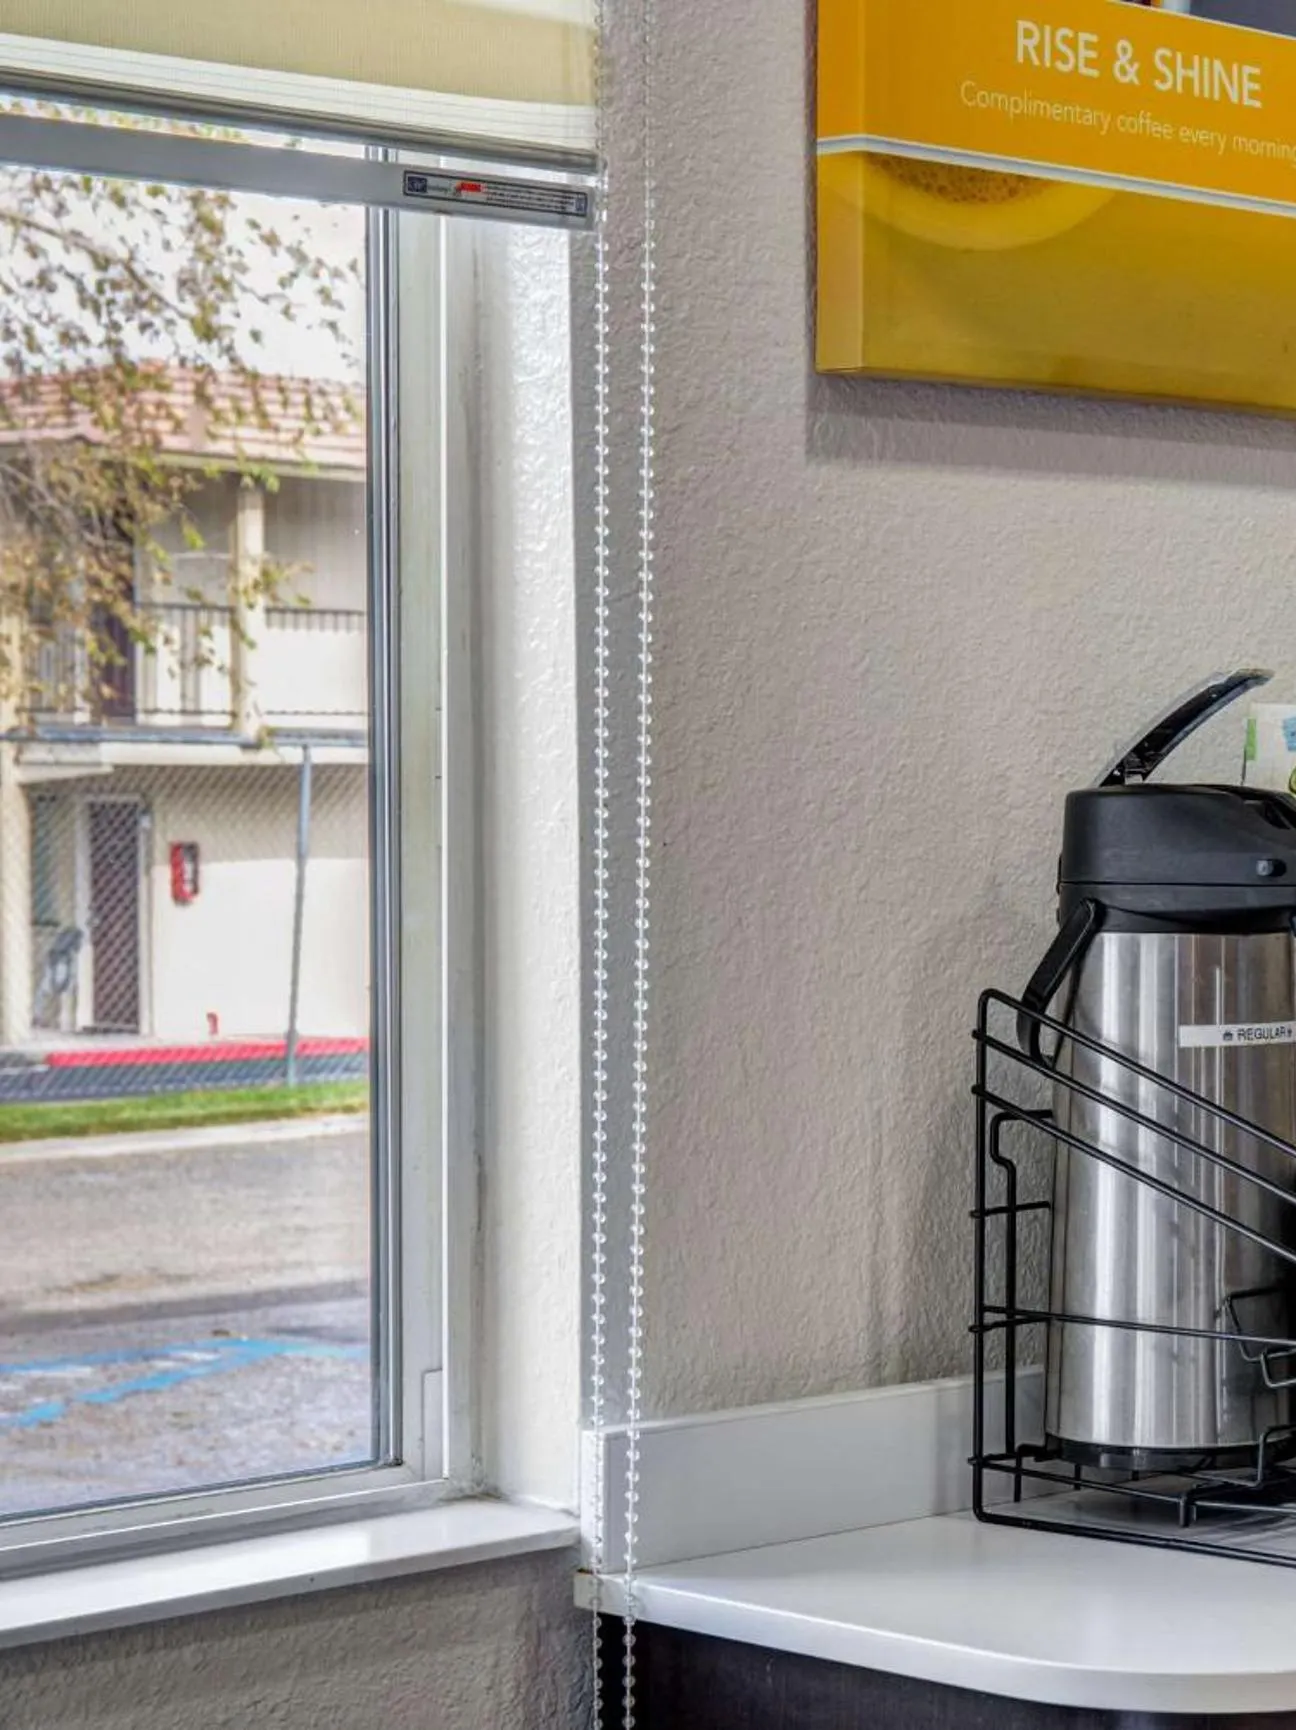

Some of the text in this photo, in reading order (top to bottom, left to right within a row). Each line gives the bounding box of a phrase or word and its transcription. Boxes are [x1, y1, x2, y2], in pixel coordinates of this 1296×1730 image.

[1016, 20, 1262, 108] RISE & SHINE
[961, 80, 1111, 135] Complimentary
[1118, 110, 1173, 140] coffee
[1179, 124, 1226, 154] every
[1237, 1026, 1285, 1041] REGULAR
